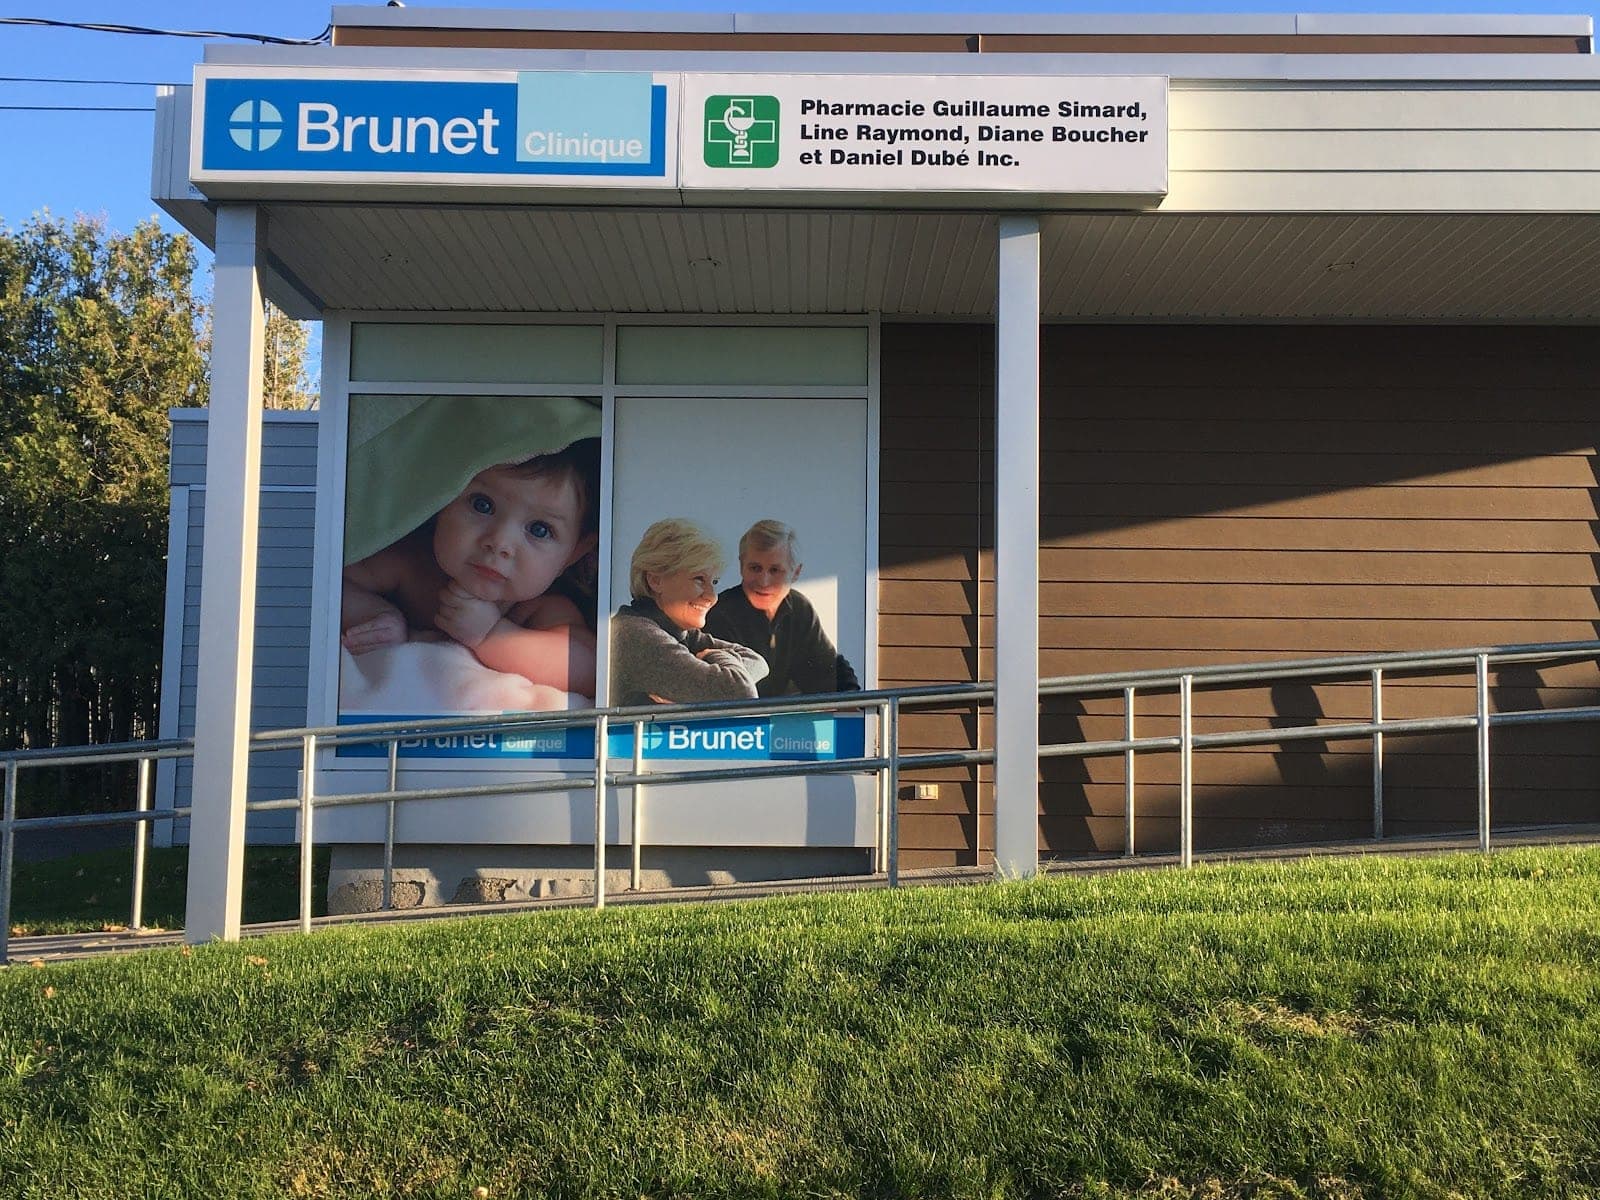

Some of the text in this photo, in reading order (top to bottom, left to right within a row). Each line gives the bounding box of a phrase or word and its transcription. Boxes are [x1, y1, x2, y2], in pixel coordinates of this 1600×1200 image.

[801, 99, 1147, 121] Pharmacie Guillaume Simard,
[298, 102, 643, 163] Brunet Clinique
[800, 124, 1149, 145] Line Raymond, Diane Boucher
[799, 148, 1020, 167] et Daniel Dubé Inc.
[506, 736, 563, 753] Clinique
[668, 725, 830, 754] Brunet Clinique
